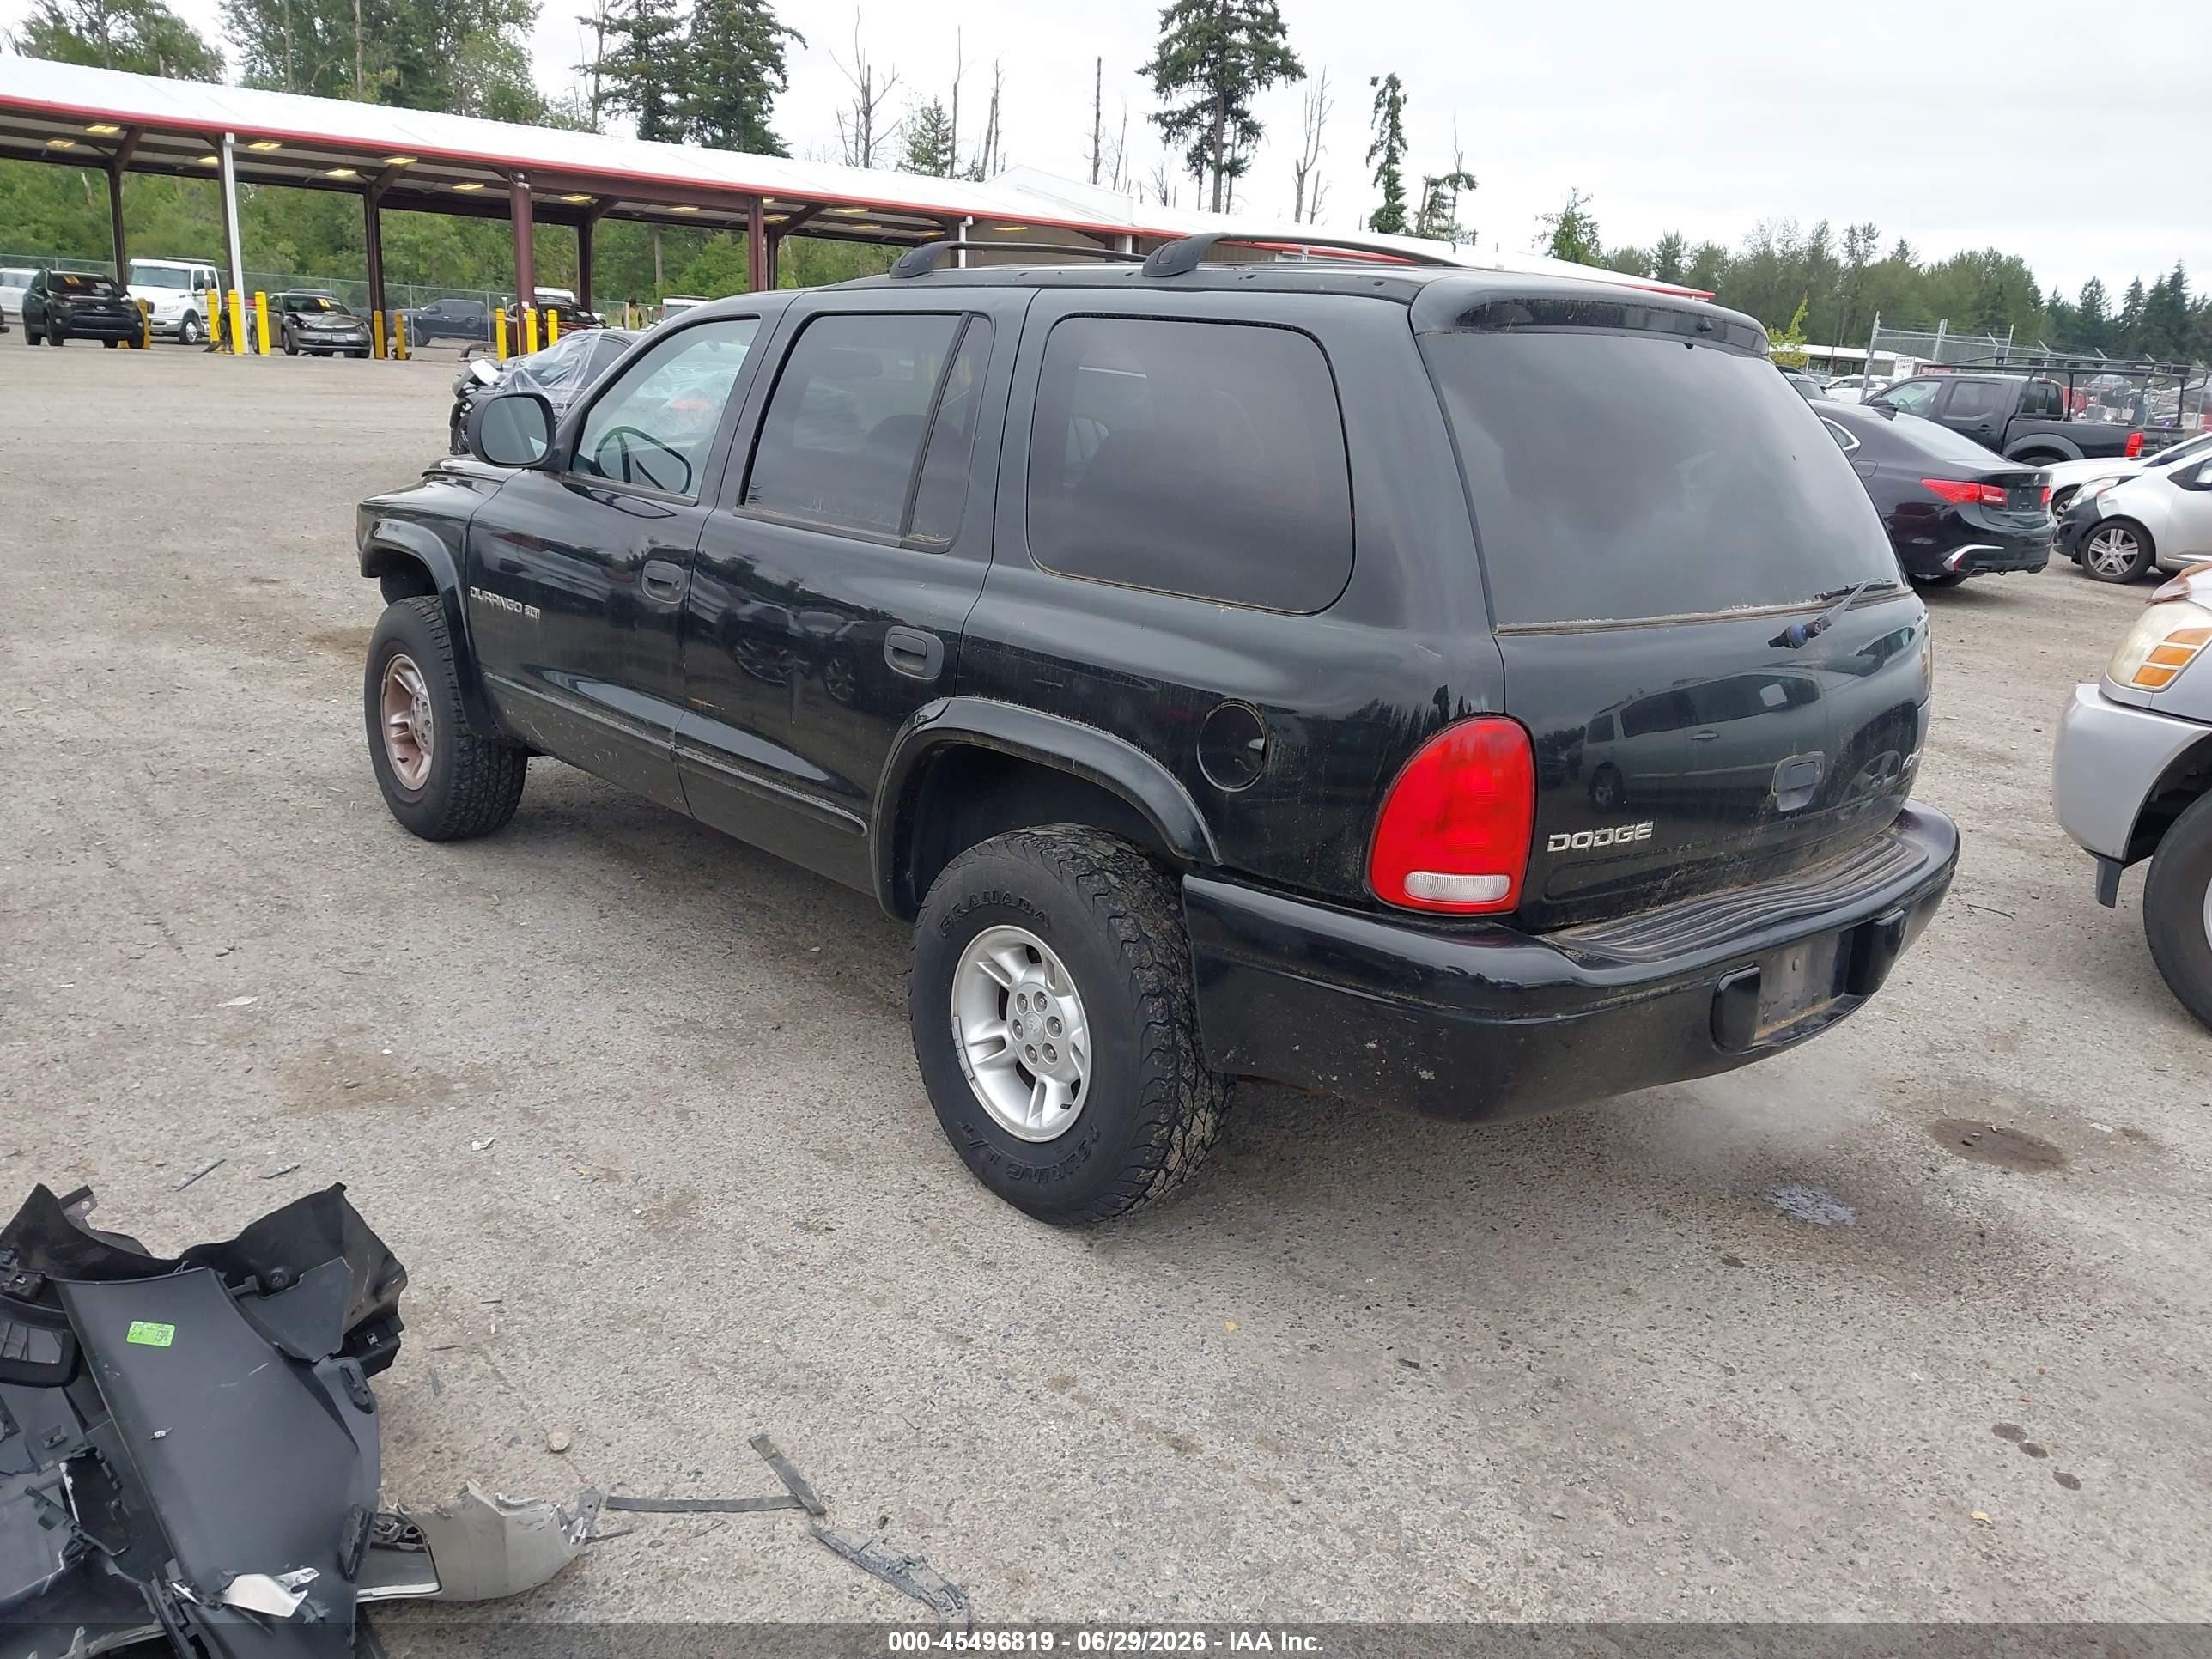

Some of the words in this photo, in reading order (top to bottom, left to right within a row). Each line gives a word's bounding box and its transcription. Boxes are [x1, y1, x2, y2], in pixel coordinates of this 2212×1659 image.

[469, 586, 523, 613] DURANGO
[1547, 821, 1654, 852] DODGE
[939, 890, 1049, 937] GRANADA
